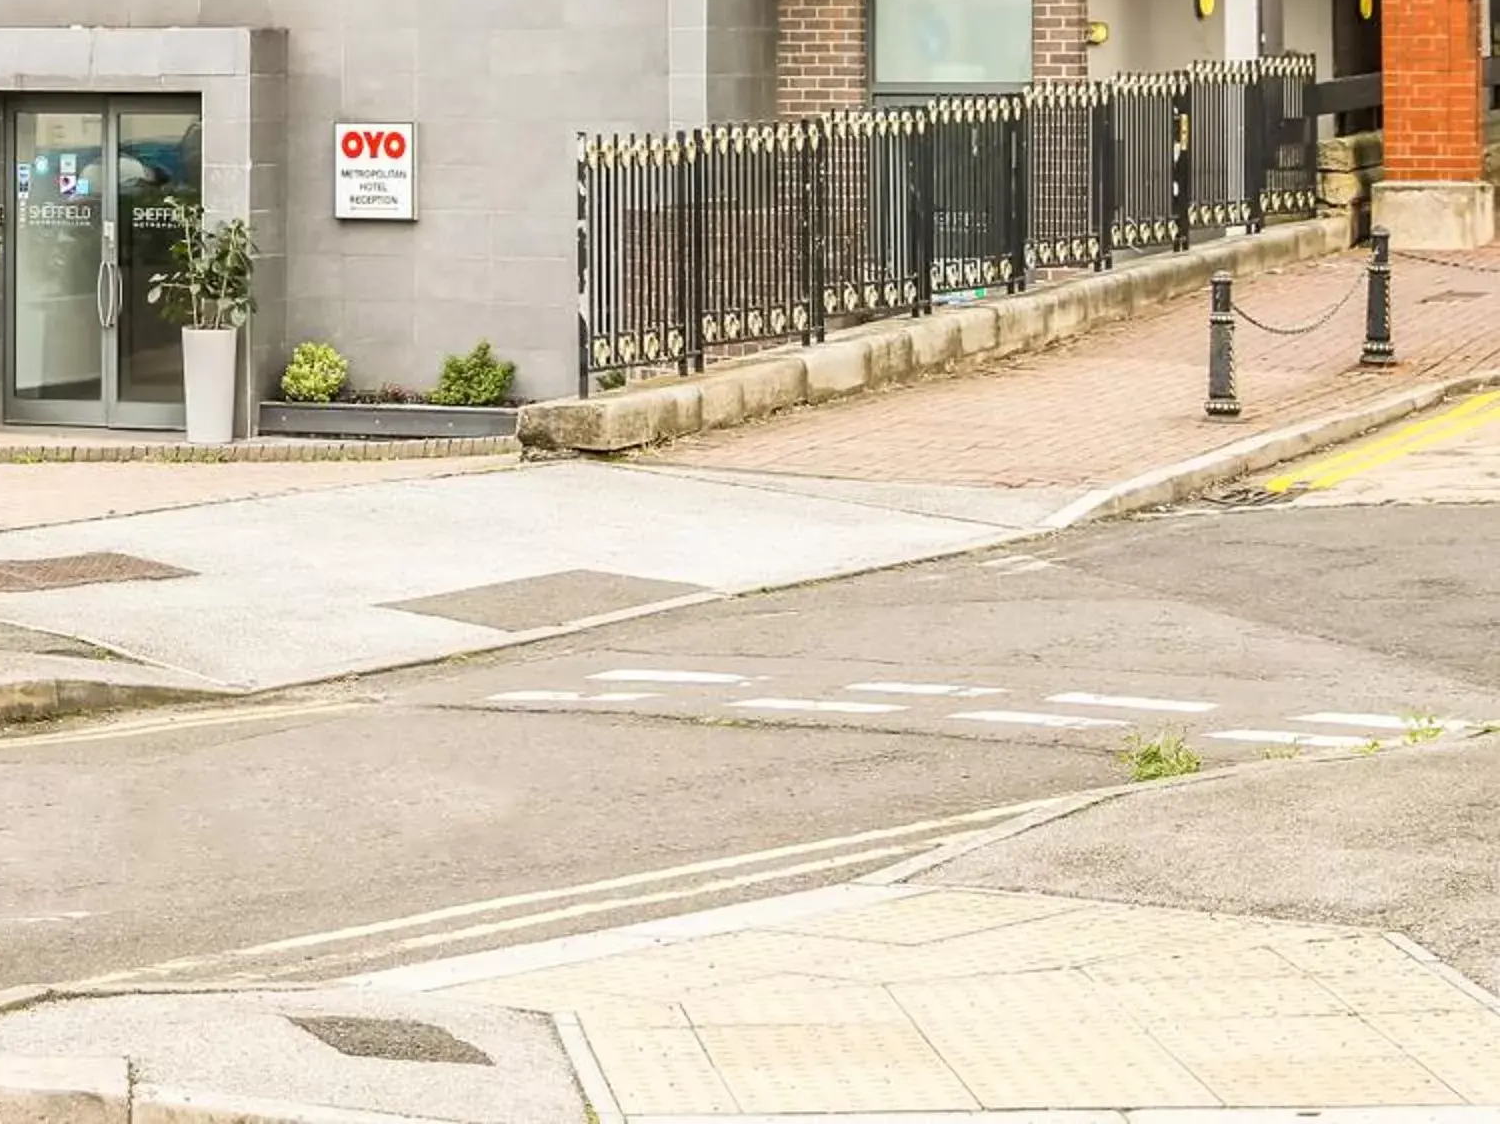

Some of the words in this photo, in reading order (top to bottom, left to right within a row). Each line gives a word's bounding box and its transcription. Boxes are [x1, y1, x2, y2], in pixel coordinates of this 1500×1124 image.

[341, 131, 406, 159] OYO
[341, 168, 407, 179] METROPOLITAN
[359, 182, 388, 192] HOTEL
[349, 195, 399, 205] RECEPTION
[29, 205, 91, 219] SHEFFIELD
